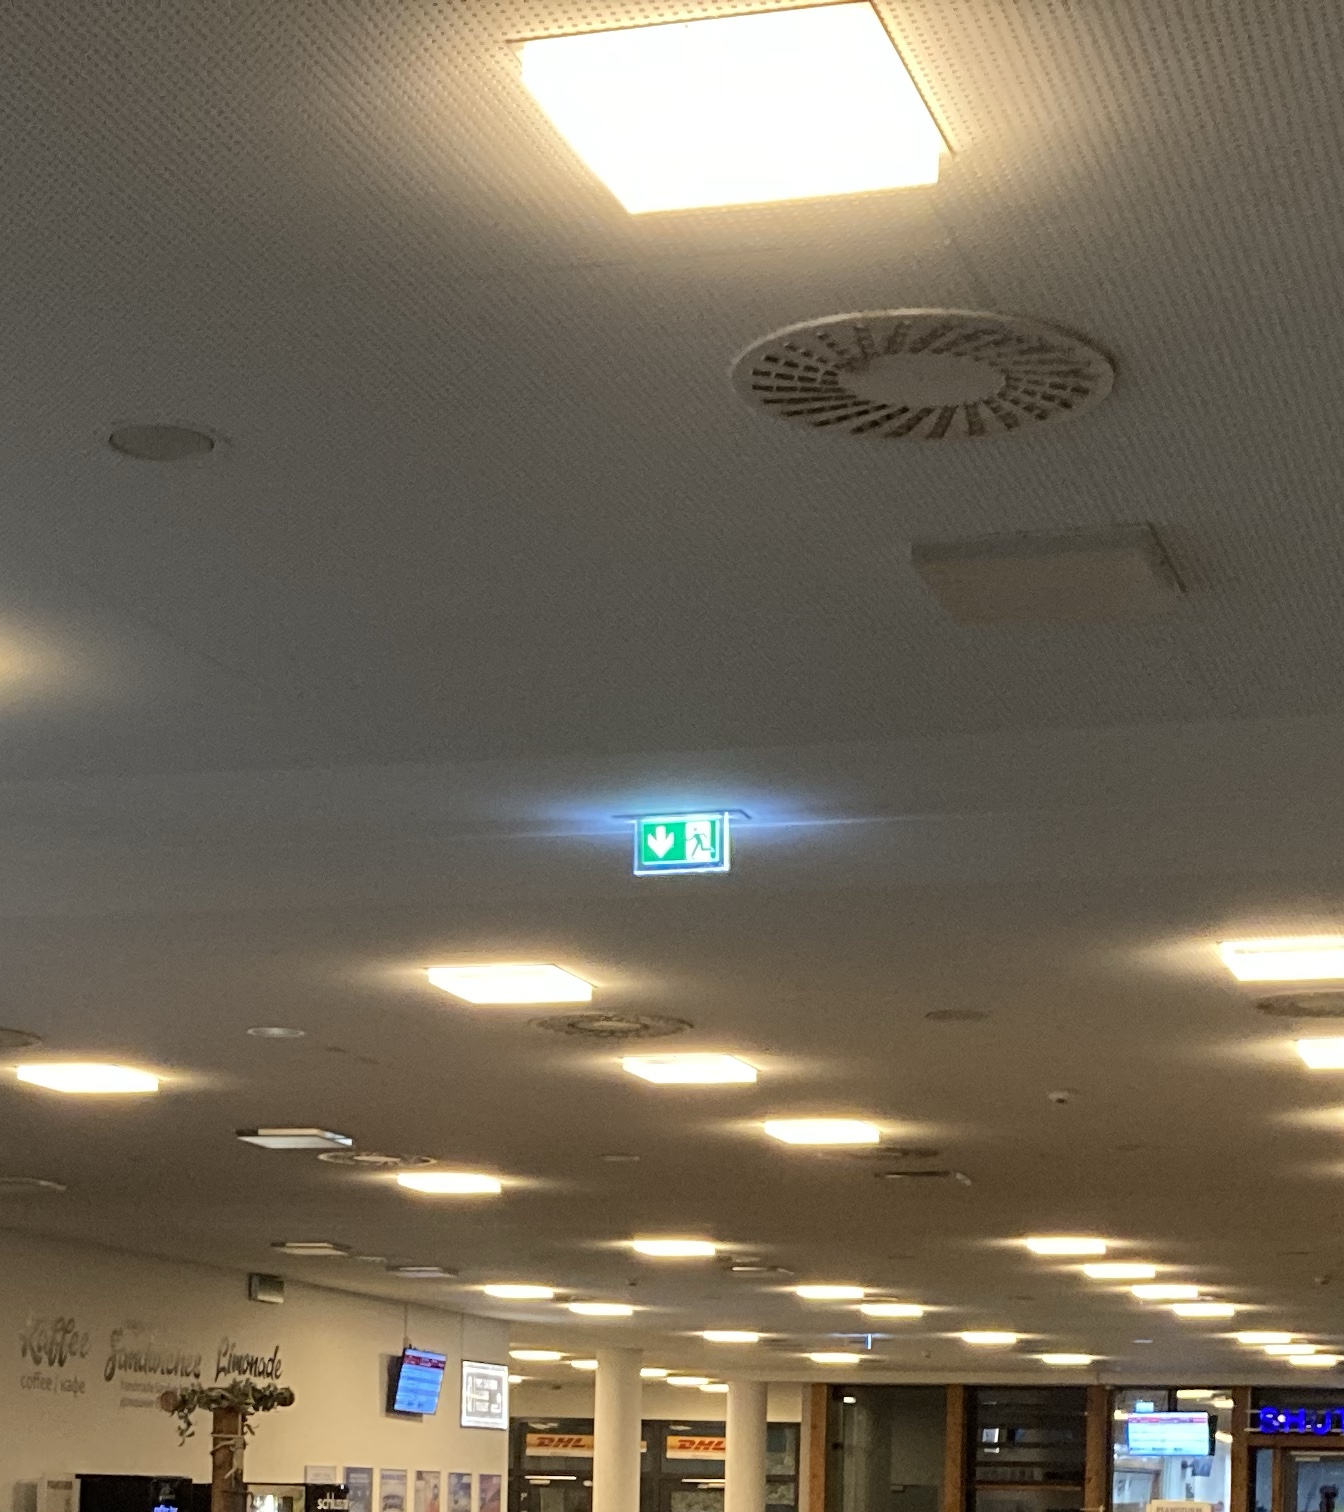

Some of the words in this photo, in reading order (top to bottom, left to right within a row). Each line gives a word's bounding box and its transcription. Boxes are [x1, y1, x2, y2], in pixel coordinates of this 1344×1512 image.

[214, 1335, 284, 1383] Limonade
[536, 1436, 586, 1448] DHL
[677, 1438, 726, 1451] DHL
